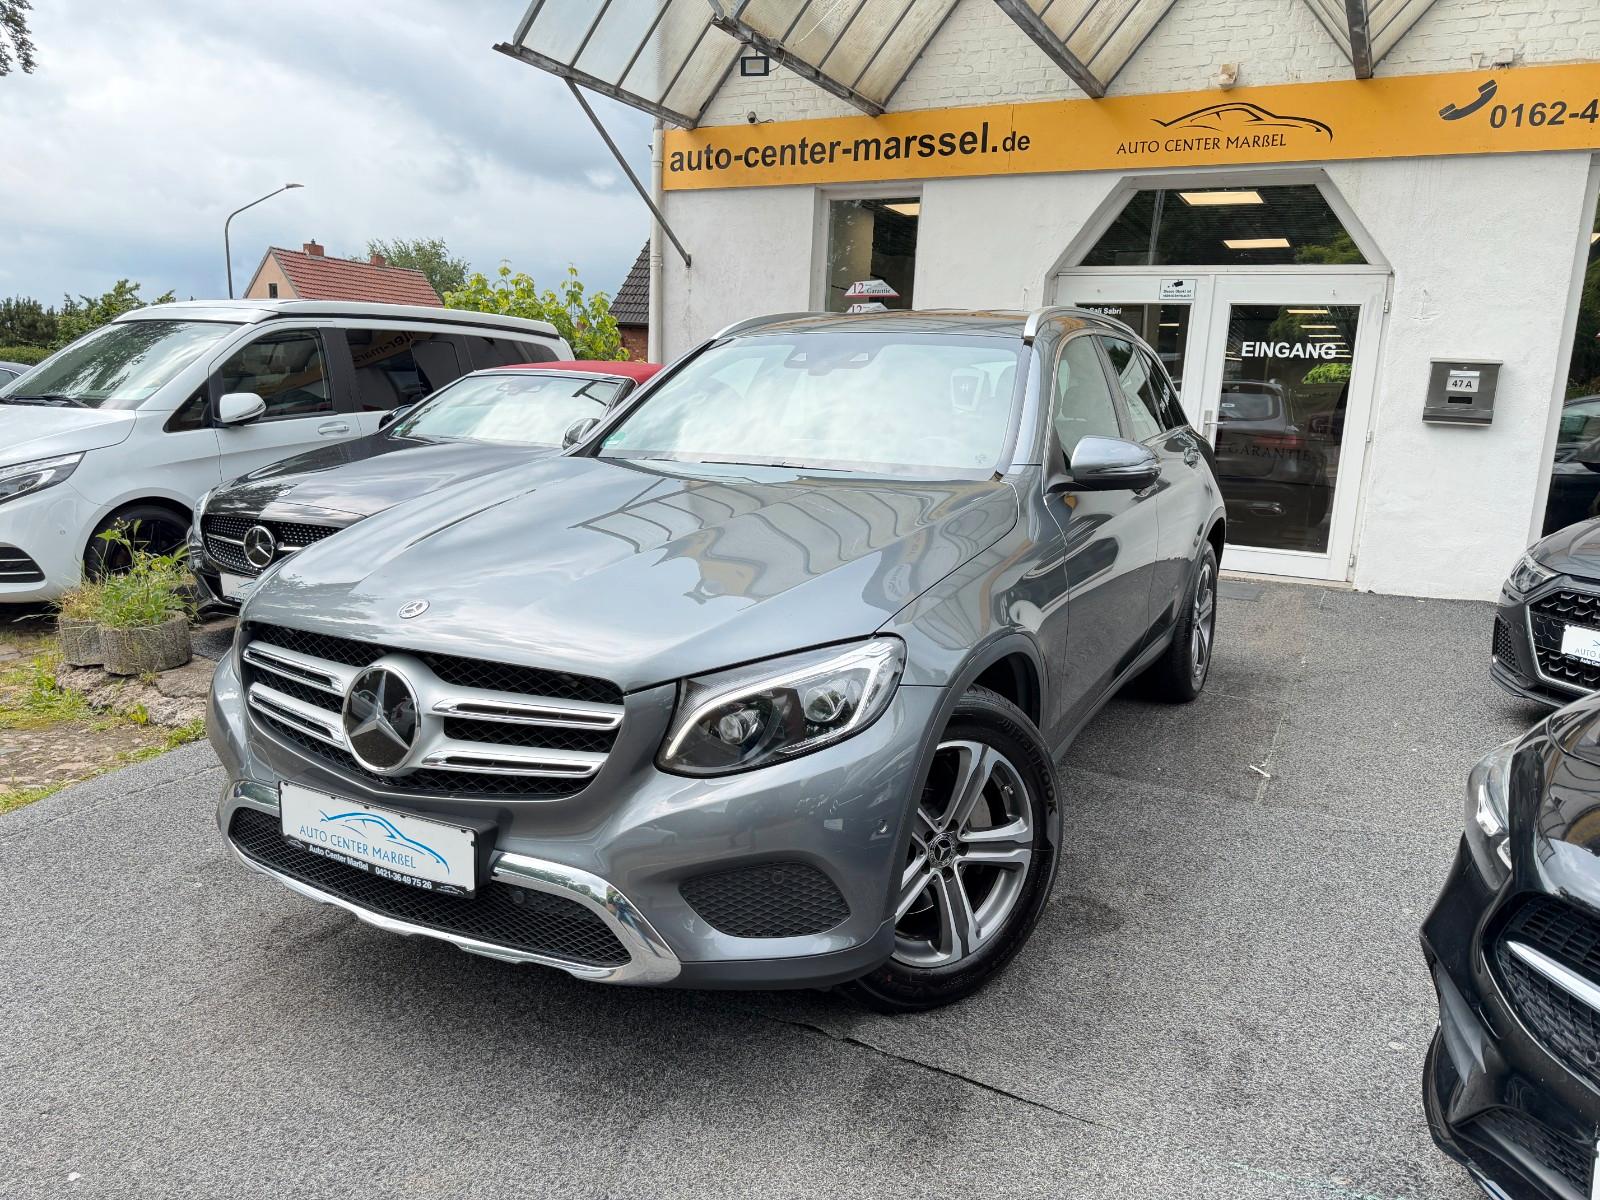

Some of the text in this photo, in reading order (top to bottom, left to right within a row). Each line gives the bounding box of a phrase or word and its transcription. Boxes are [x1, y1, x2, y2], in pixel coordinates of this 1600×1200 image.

[1488, 98, 1600, 130] 0162-4
[669, 121, 1031, 172] auto-center-marssel.de
[1116, 138, 1161, 155] AUTO
[1164, 136, 1221, 153] CENTER
[851, 282, 864, 294] 12
[1241, 341, 1337, 360] EINGANG
[1451, 379, 1472, 388] 47 A
[1574, 648, 1596, 658] AUTO
[300, 824, 327, 843] AUTO
[331, 834, 369, 855] CENTER
[309, 845, 324, 857] Auto
[325, 849, 347, 864] Center
[375, 867, 402, 882] 0421-36
[402, 874, 412, 885] 49
[412, 877, 422, 887] 75
[422, 879, 432, 890] 26
